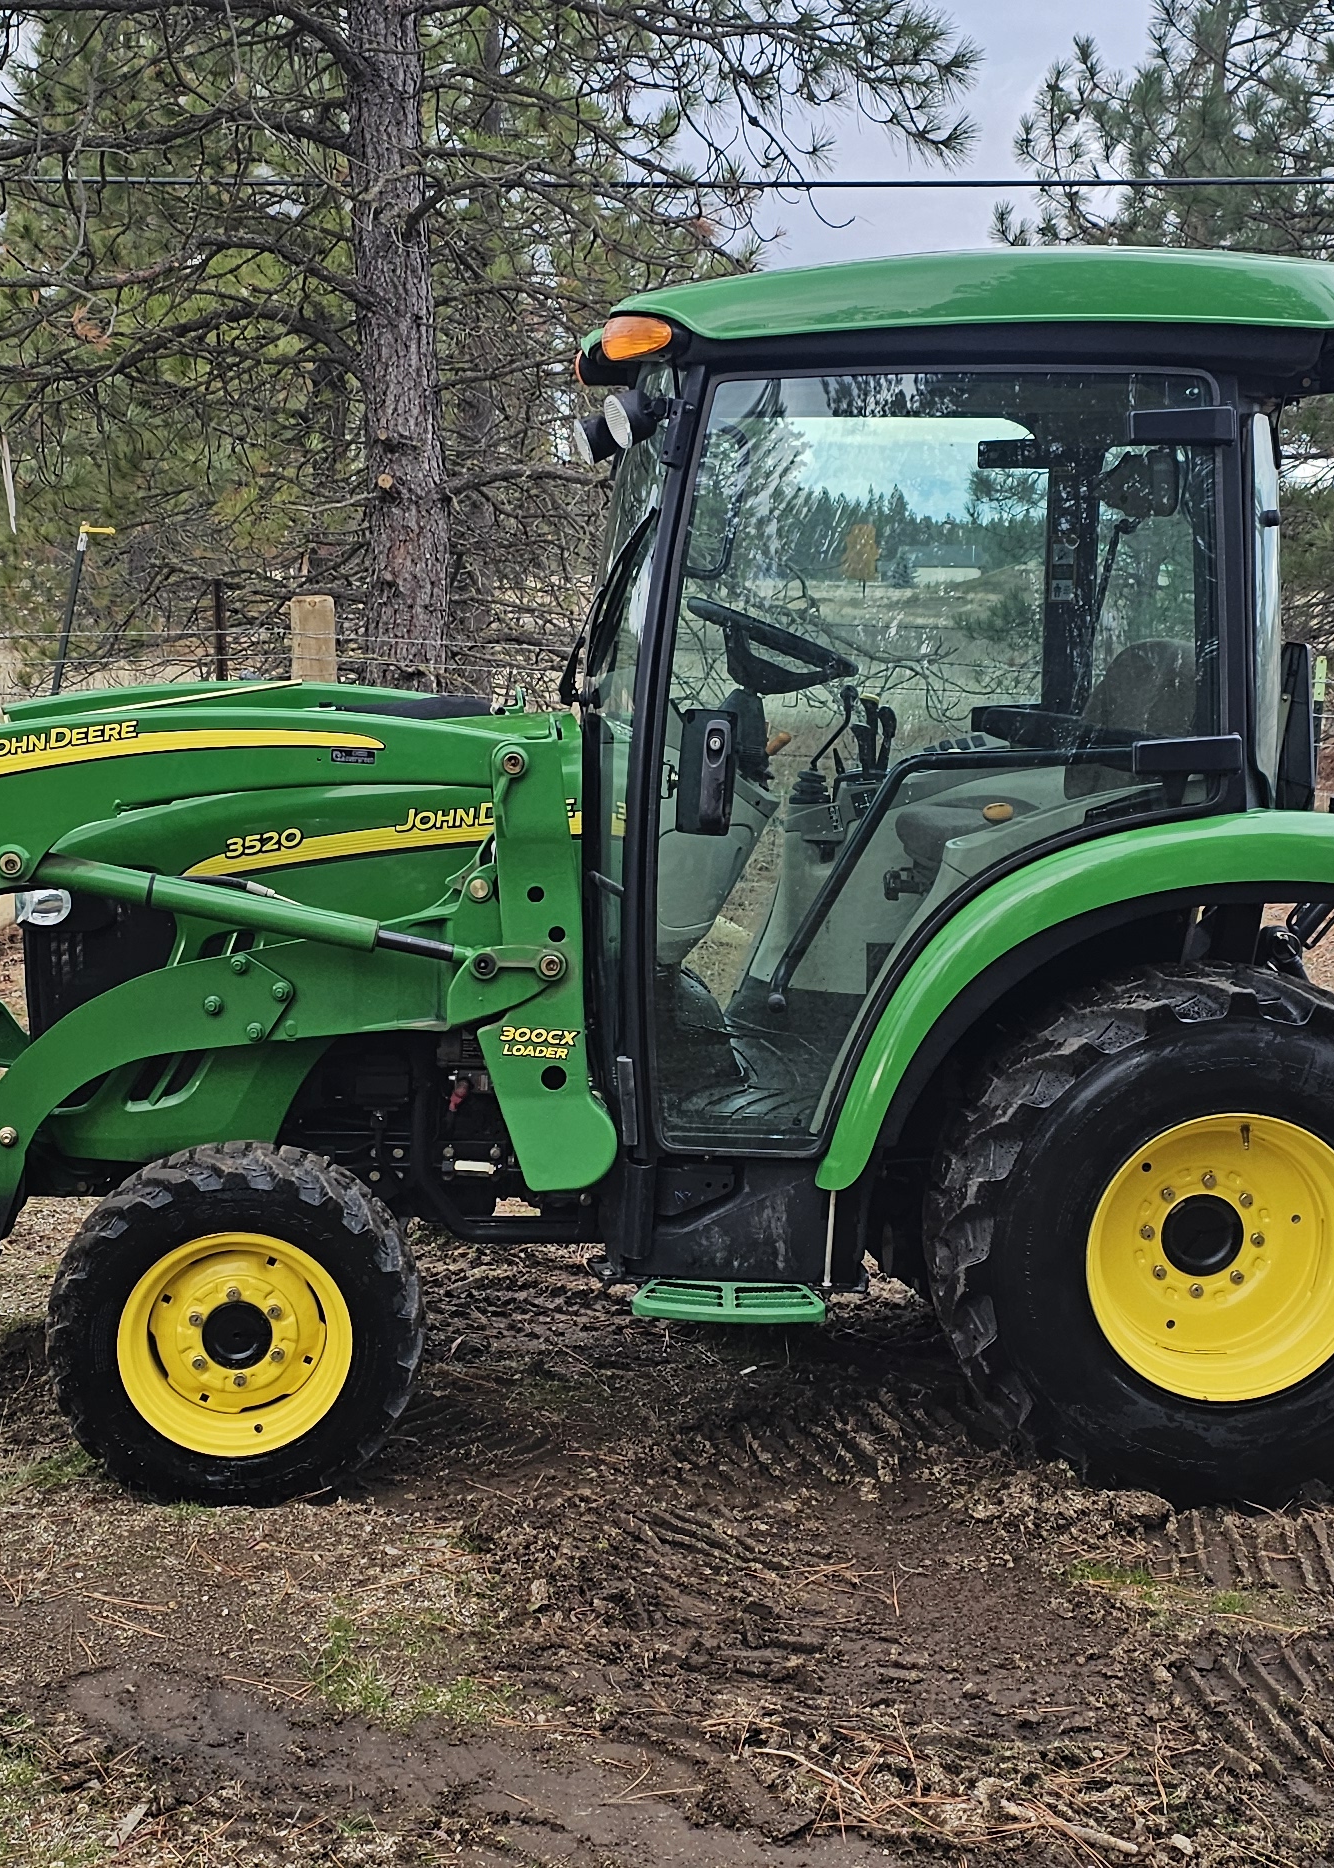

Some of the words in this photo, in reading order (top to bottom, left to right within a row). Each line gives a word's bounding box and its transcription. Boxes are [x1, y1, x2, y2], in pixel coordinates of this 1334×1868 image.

[49, 720, 138, 748] DEERE
[395, 808, 475, 832] JOHN
[226, 828, 303, 858] 3520
[500, 1026, 578, 1046] 300CX
[503, 1044, 569, 1060] LOADER
